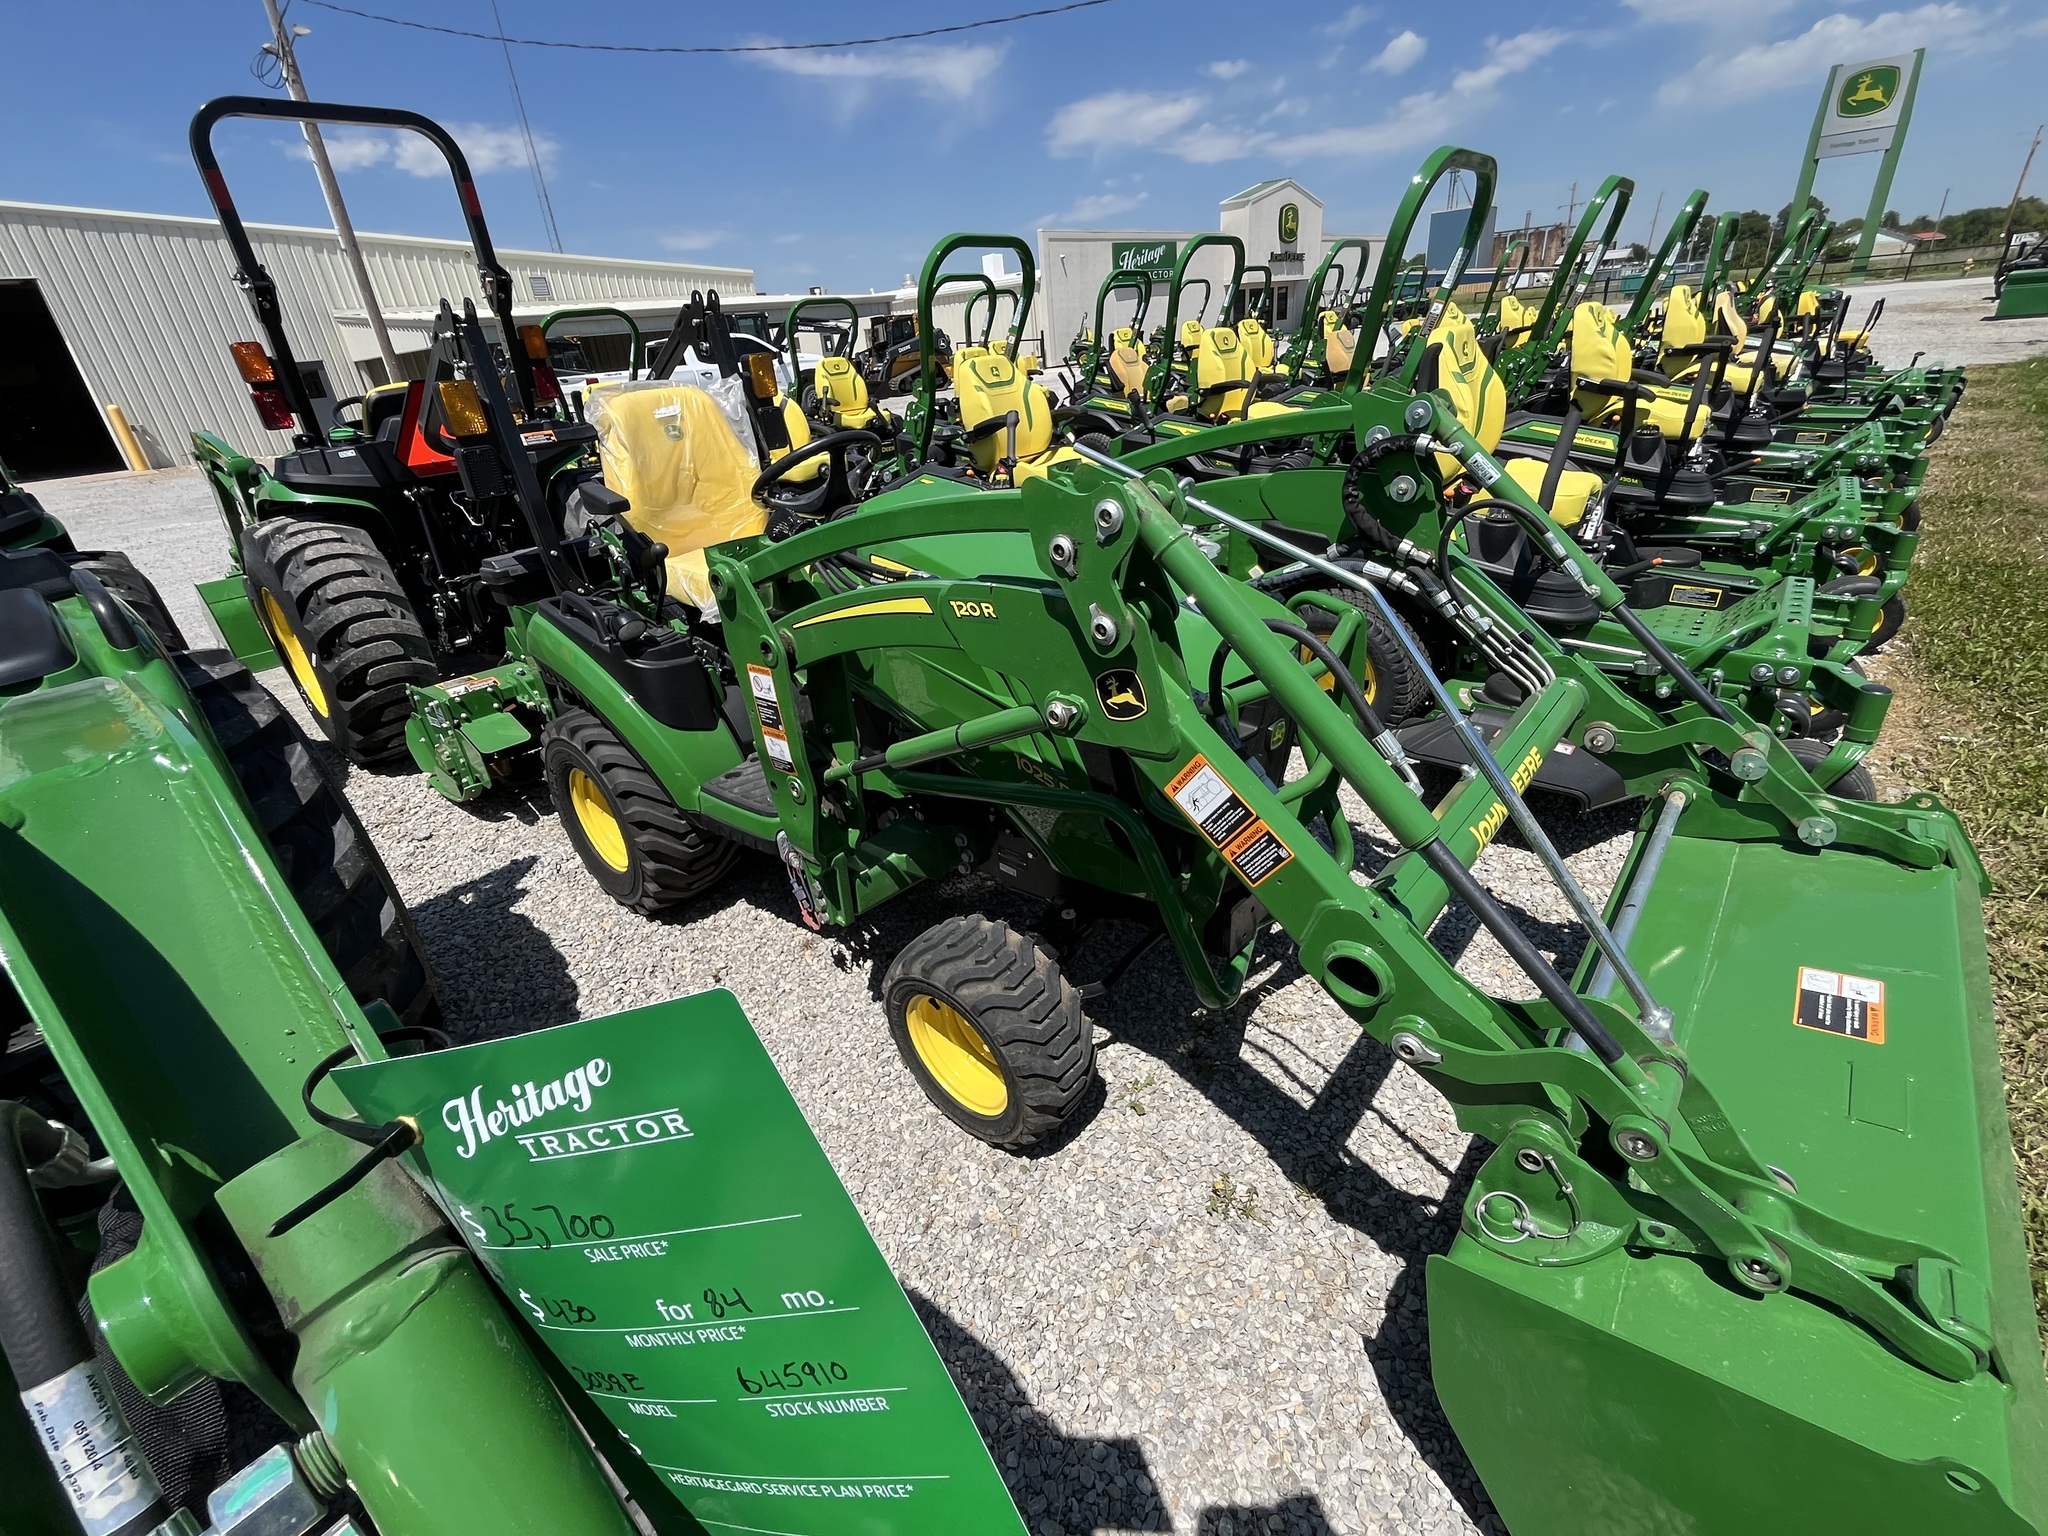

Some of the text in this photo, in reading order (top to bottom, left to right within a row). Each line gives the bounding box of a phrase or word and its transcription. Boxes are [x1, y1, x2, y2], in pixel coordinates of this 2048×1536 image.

[1118, 244, 1166, 270] Heritage
[1148, 269, 1174, 280] CTOR
[898, 344, 911, 353] DEERE
[1671, 390, 1689, 398] DEERE
[1584, 436, 1608, 446] DEERE
[1619, 476, 1639, 485] 30M
[1176, 760, 1202, 787] WARNING
[1509, 745, 1543, 798] EERE
[1235, 826, 1264, 851] WARNING
[1468, 796, 1509, 858] JOHN
[442, 1058, 612, 1159] Heritage
[517, 1113, 691, 1158] TRACTOR
[583, 1245, 623, 1264] SALE
[655, 1299, 696, 1323] for
[702, 1287, 754, 1319] 84
[779, 1289, 835, 1311] mo.
[624, 1329, 696, 1349] MONTHLY
[735, 1361, 849, 1394] 645910
[627, 1401, 678, 1419] MODEL
[765, 1397, 890, 1418] STOCK NUMBER
[34, 1401, 47, 1426] Fab.
[45, 1426, 61, 1452] Date
[668, 1472, 764, 1495] HERITAGEGARD
[765, 1482, 822, 1498] SERVICE
[822, 1484, 864, 1499] PLAN
